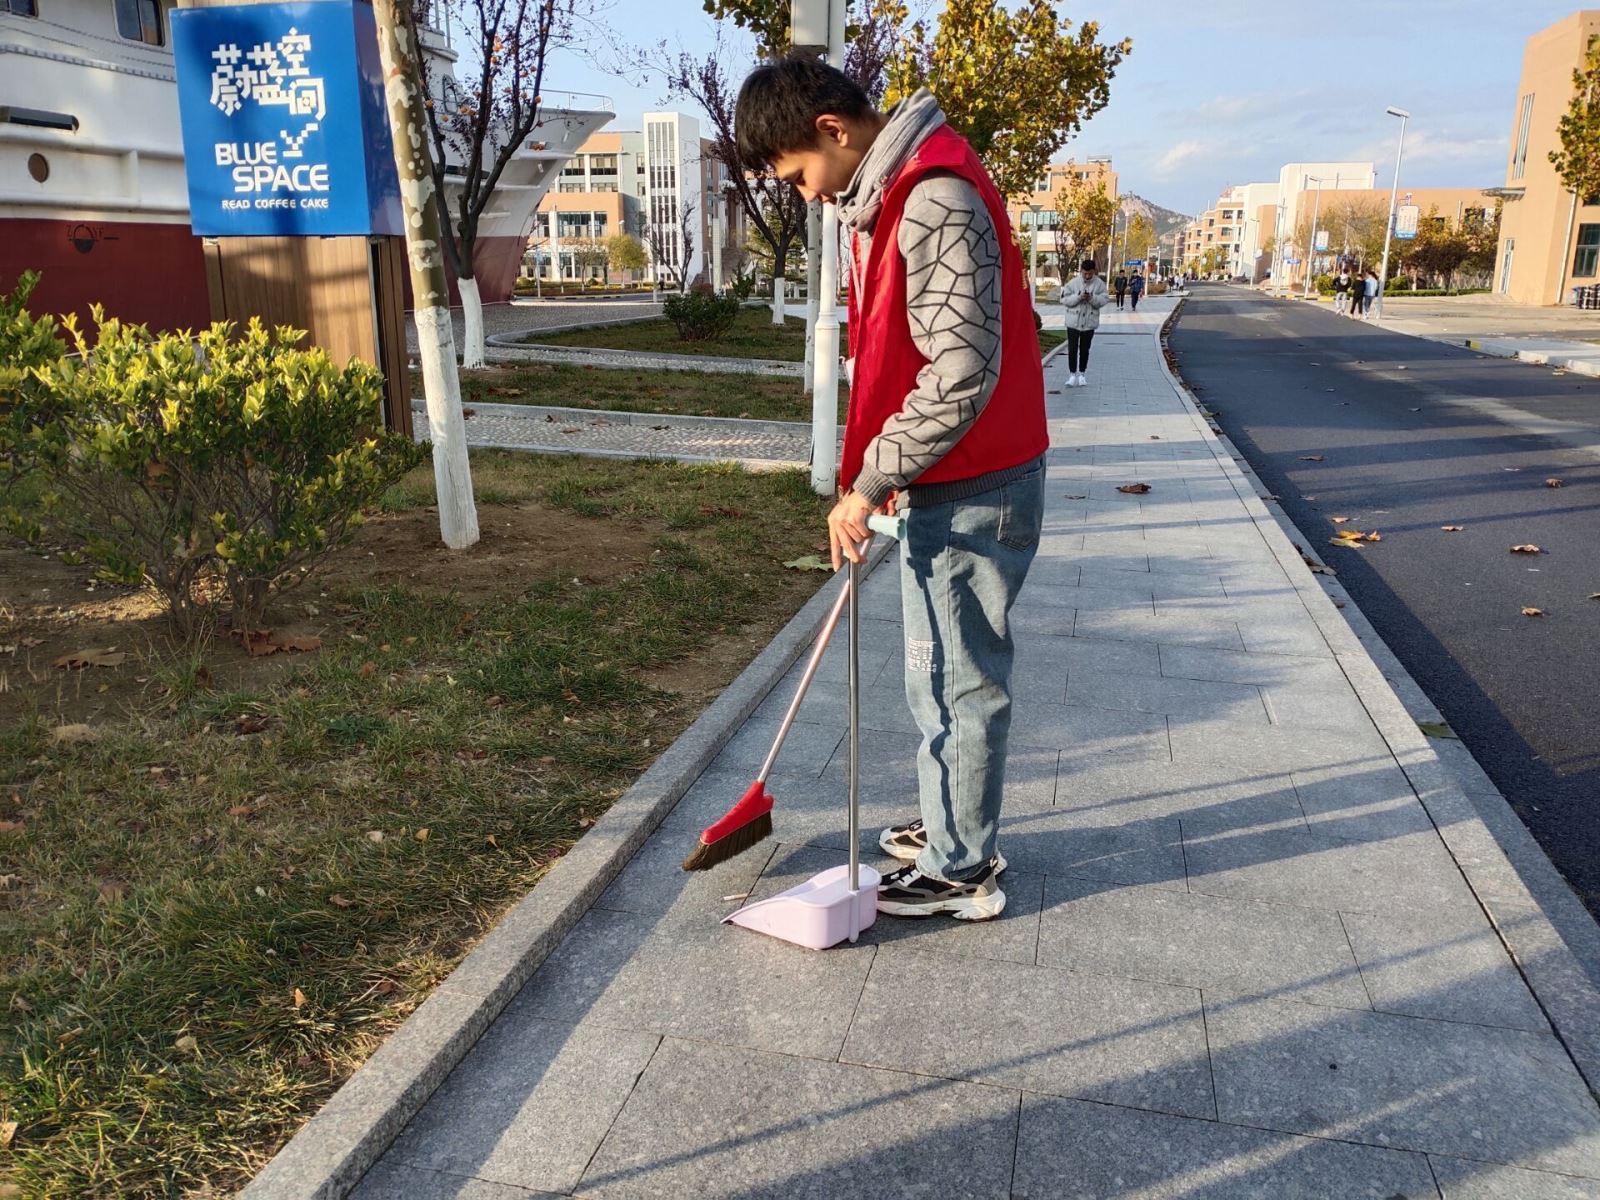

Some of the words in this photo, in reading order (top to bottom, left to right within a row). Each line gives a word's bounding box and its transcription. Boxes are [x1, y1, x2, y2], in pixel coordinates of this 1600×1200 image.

[215, 142, 278, 166] BLUE
[232, 164, 330, 192] SPACE
[222, 199, 251, 209] READ
[254, 198, 297, 209] COFFEE
[300, 198, 329, 208] CAKE
